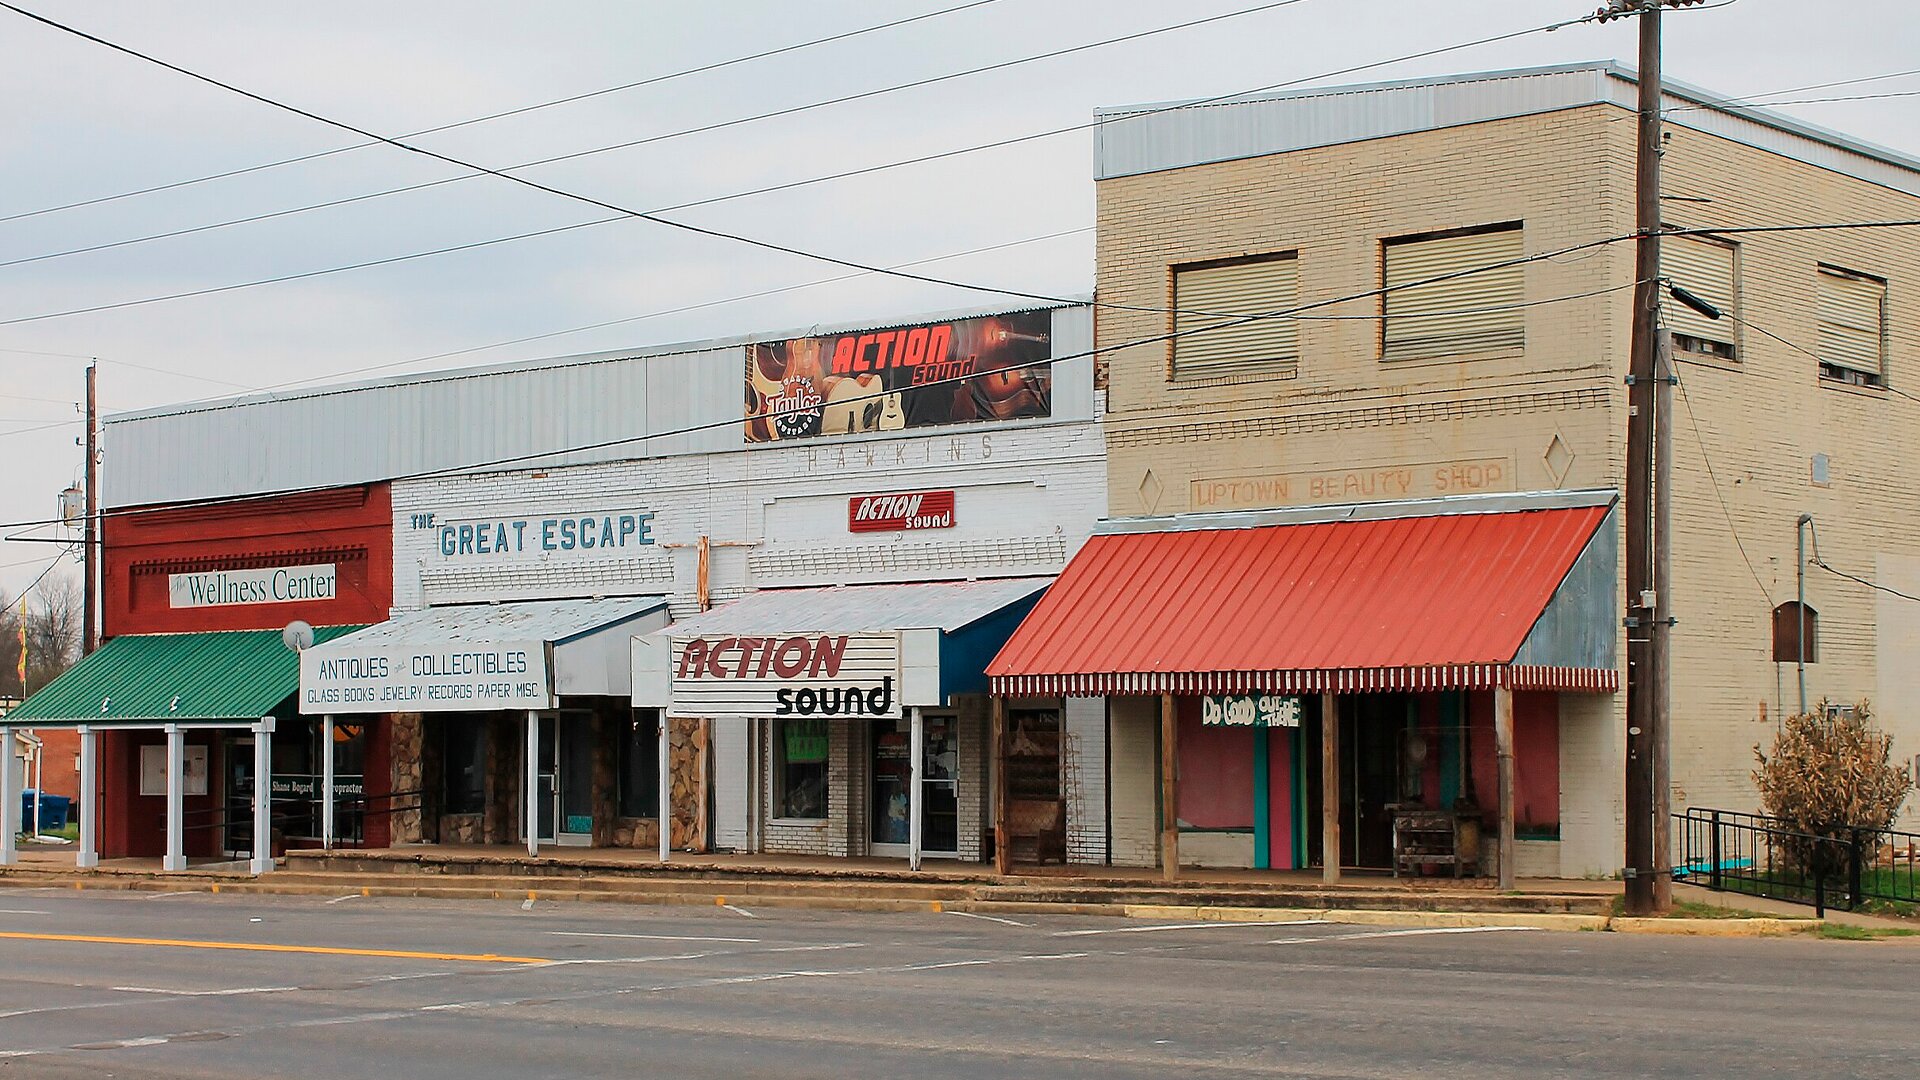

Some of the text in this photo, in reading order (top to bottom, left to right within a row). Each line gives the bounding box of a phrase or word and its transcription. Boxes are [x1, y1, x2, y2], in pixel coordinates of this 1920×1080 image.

[831, 325, 951, 374] ACTION
[765, 388, 821, 424] Taylor
[808, 434, 992, 471] HAWKINS
[1195, 463, 1502, 506] UPTOWN BEAUTY SHOP
[411, 513, 435, 530] THE
[855, 494, 924, 520] ACTION
[441, 513, 656, 556] GREAT ESCAPE
[188, 574, 267, 604] Wellness
[272, 569, 335, 600] Center
[318, 657, 389, 681] ANTIQUES
[411, 651, 527, 677] COLLECTIBLES
[677, 635, 849, 679] ACTION
[307, 688, 340, 704] GLASS
[344, 687, 375, 702] BOOKS
[379, 685, 423, 701] JEWELRY
[428, 684, 473, 700] RECORDS
[477, 683, 511, 698] PAPER
[272, 781, 290, 792] Shane
[291, 781, 314, 795] Bogard
